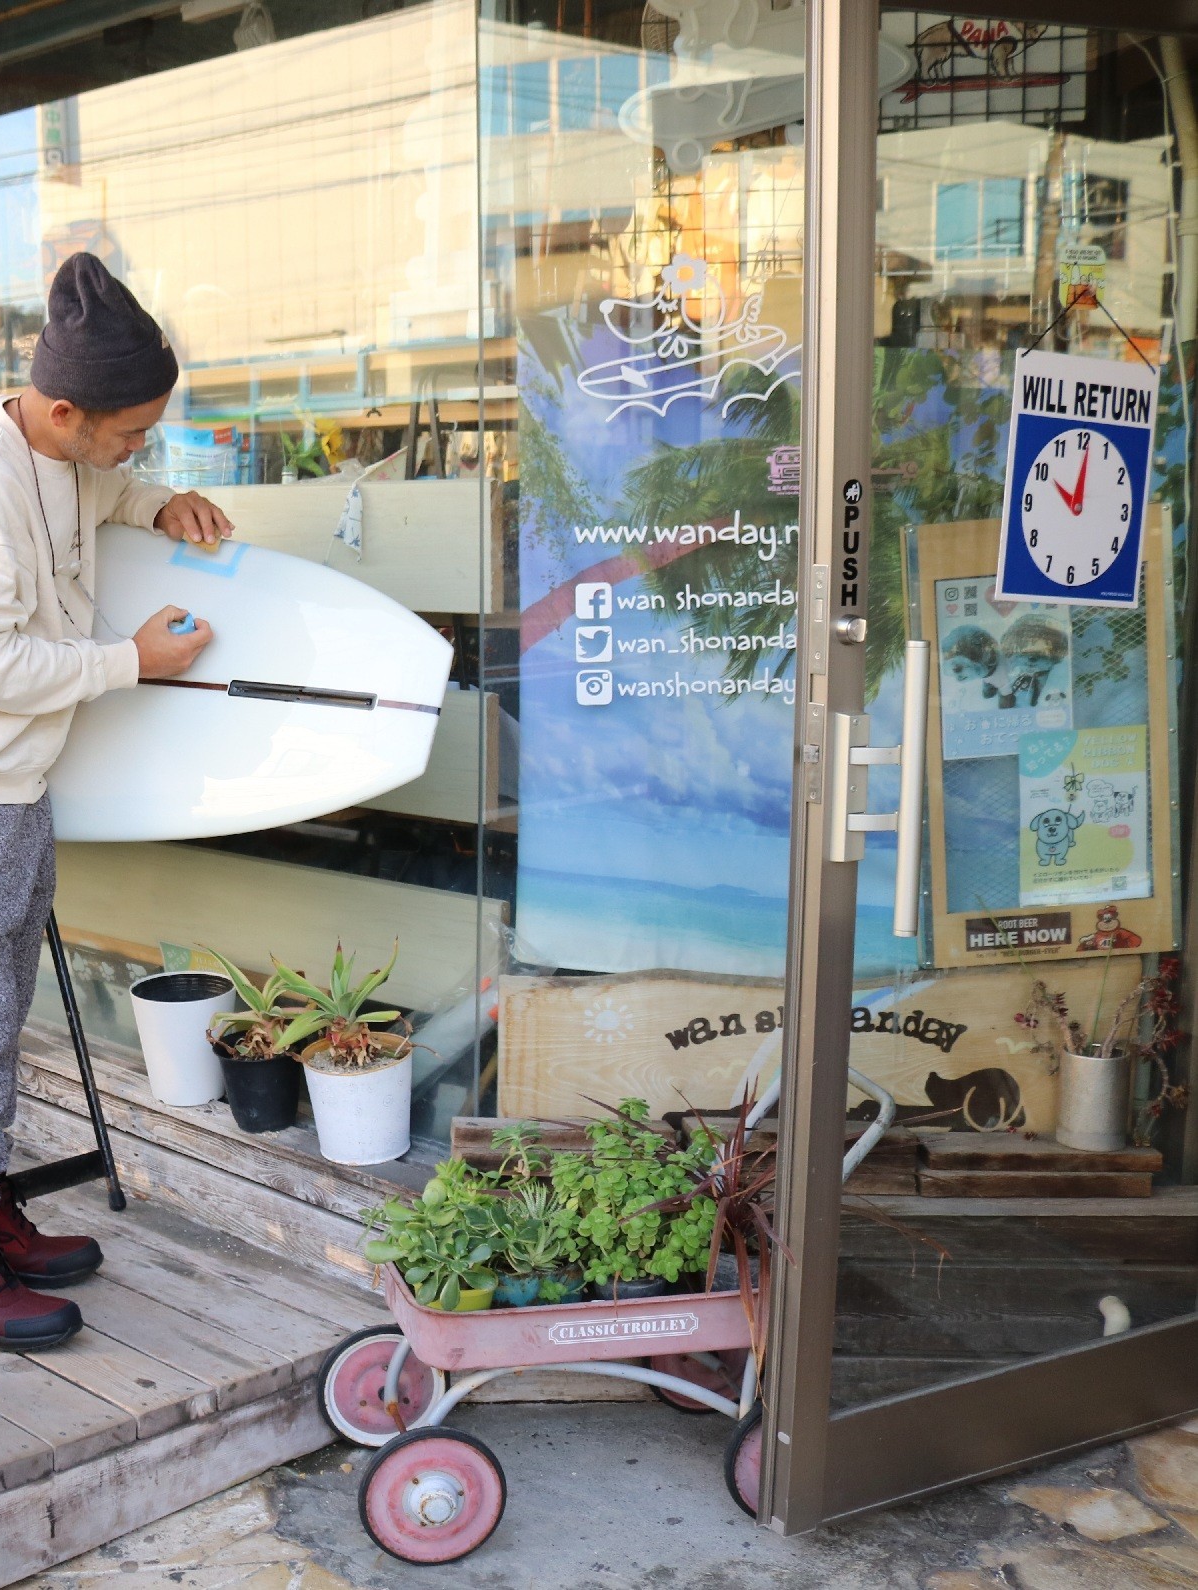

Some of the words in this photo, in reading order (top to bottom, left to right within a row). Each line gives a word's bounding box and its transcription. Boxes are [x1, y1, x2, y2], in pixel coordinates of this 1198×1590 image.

[1023, 375, 1067, 414] WILL
[1074, 381, 1151, 424] RETURN
[1054, 439, 1066, 458] 11
[1077, 432, 1091, 451] 12
[1103, 441, 1109, 460] 1
[1034, 462, 1049, 482] 10
[1117, 467, 1126, 485] 2
[1024, 493, 1033, 512] 9
[1121, 503, 1129, 522] 3
[1029, 529, 1038, 548] 8
[1111, 536, 1119, 554] 4
[841, 505, 860, 606] PUSH
[1046, 555, 1053, 573] 7
[1066, 565, 1075, 584] 6
[1091, 558, 1100, 576] 5
[617, 594, 666, 611] wan
[676, 579, 799, 616] shonanda
[1019, 918, 1039, 929] BEER
[970, 931, 1019, 948] HERE
[1024, 928, 1067, 944] NOW
[664, 1013, 747, 1051] wan
[559, 1323, 619, 1339] CLASSIC
[621, 1318, 689, 1335] TROLLEY
